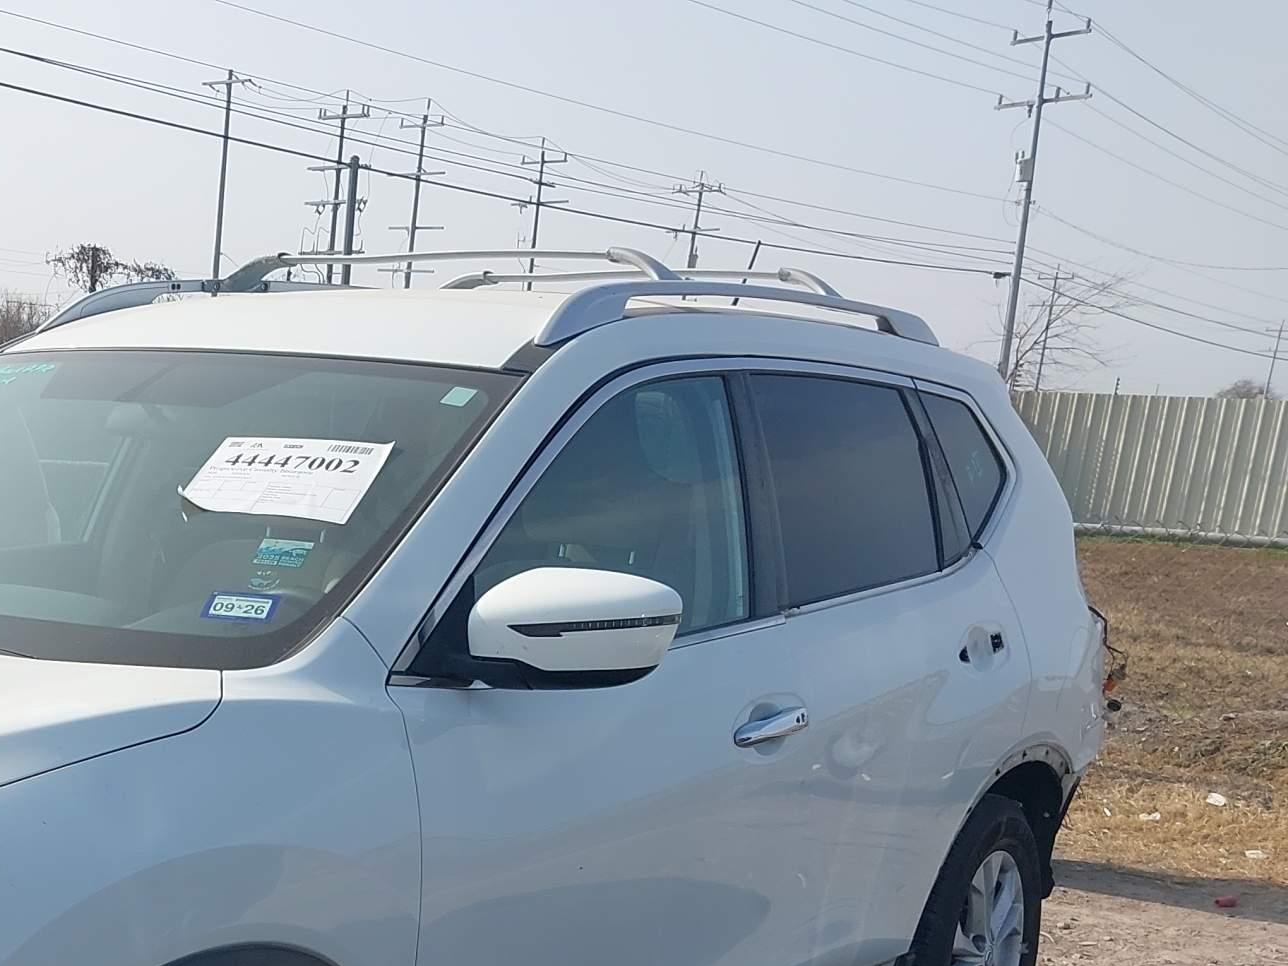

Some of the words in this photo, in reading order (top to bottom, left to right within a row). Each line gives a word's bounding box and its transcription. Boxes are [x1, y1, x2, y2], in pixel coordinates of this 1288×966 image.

[225, 453, 360, 474] 44447002
[213, 602, 235, 613] 09
[242, 604, 266, 616] 26
